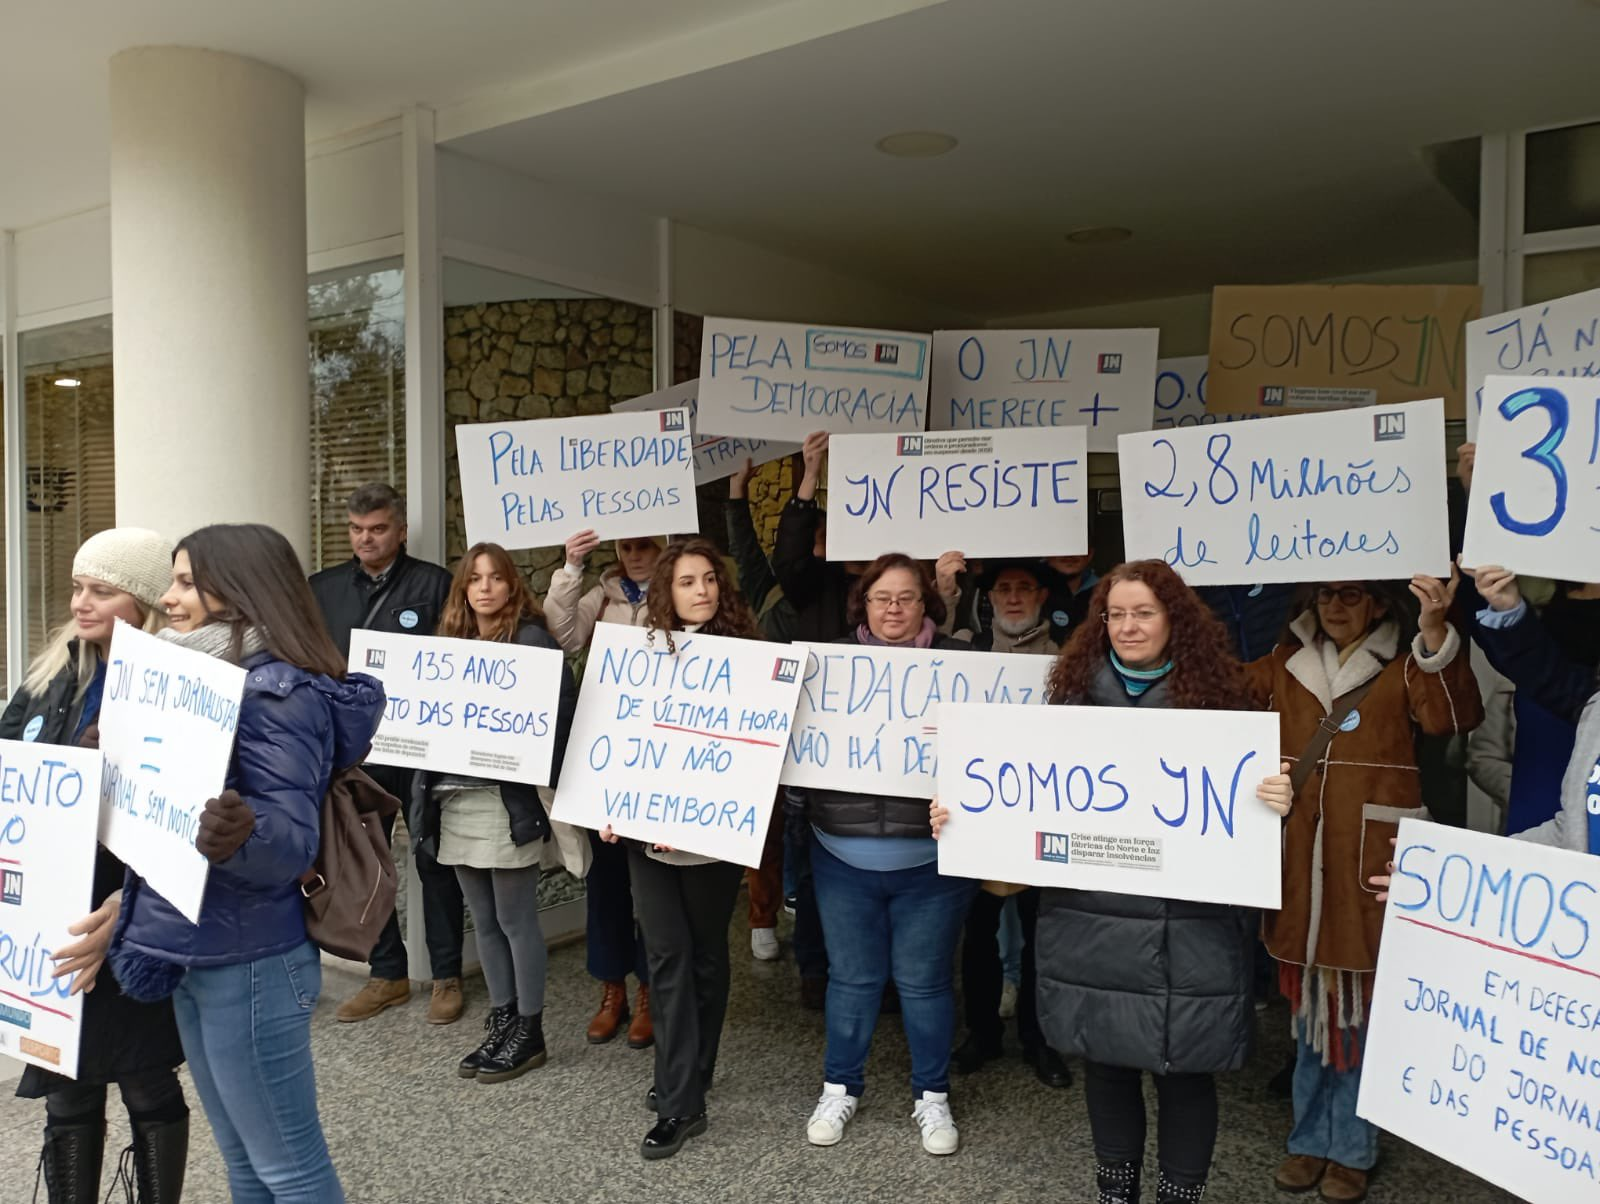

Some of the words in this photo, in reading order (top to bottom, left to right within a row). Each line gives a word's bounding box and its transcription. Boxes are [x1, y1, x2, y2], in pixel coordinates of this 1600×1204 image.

[710, 333, 792, 378] PELA
[813, 333, 867, 359] SOMOS
[958, 336, 985, 381] O
[1016, 337, 1071, 381] JN
[1219, 312, 1399, 375] SOMOS
[1390, 304, 1473, 391] JN
[1486, 306, 1552, 370] JÁ
[951, 397, 1066, 429] MERECE
[1377, 413, 1405, 435] JN
[703, 437, 767, 465] TRAD
[1144, 433, 1239, 507] 2,8
[1250, 457, 1412, 502] Milhões
[1489, 386, 1569, 537] 3
[501, 491, 565, 531] PELAS
[581, 487, 681, 517] PESSOAS
[845, 464, 904, 524] JN
[1163, 527, 1217, 568] de
[1245, 512, 1400, 566] leitores
[109, 659, 135, 701] JN
[138, 667, 170, 711] SEM
[411, 650, 455, 681] 135
[463, 655, 518, 690] ANOS
[599, 639, 731, 695] NOTÍCIA
[384, 696, 410, 721] TO
[416, 700, 454, 727] DAS
[464, 703, 549, 737] PESSOAS
[616, 693, 644, 721] DE
[653, 694, 729, 731] ÚLTIMA
[738, 709, 789, 732] HORA
[589, 735, 611, 772] O
[624, 738, 667, 770] JN
[682, 740, 733, 773] NÃO
[784, 725, 829, 768] NÃO
[848, 723, 882, 773] HÁ
[904, 735, 938, 778] DE
[0, 757, 83, 808] ENTO
[960, 757, 1129, 813] SOMOS
[1152, 750, 1257, 839] JN
[144, 789, 166, 827] SEM
[604, 788, 641, 821] VAI
[646, 793, 757, 837] EMBORA
[1043, 834, 1067, 855] JN
[1070, 832, 1092, 841] Crise
[1092, 834, 1117, 844] atinge
[1133, 837, 1155, 847] força
[1070, 840, 1103, 850] fábricas
[1104, 843, 1115, 851] do
[1116, 844, 1140, 853] Norte
[1147, 846, 1160, 855] faz
[1070, 848, 1104, 858] disparar
[1106, 851, 1156, 863] insolvências
[1393, 845, 1596, 959] SOMOS
[1484, 970, 1520, 1006] EM
[1404, 977, 1504, 1044] JORNAL
[1519, 1029, 1548, 1061] DE
[1453, 1043, 1485, 1082] DO
[1402, 1066, 1416, 1094] E
[1429, 1079, 1469, 1117] DAS
[1494, 1106, 1600, 1180] PESSOA
